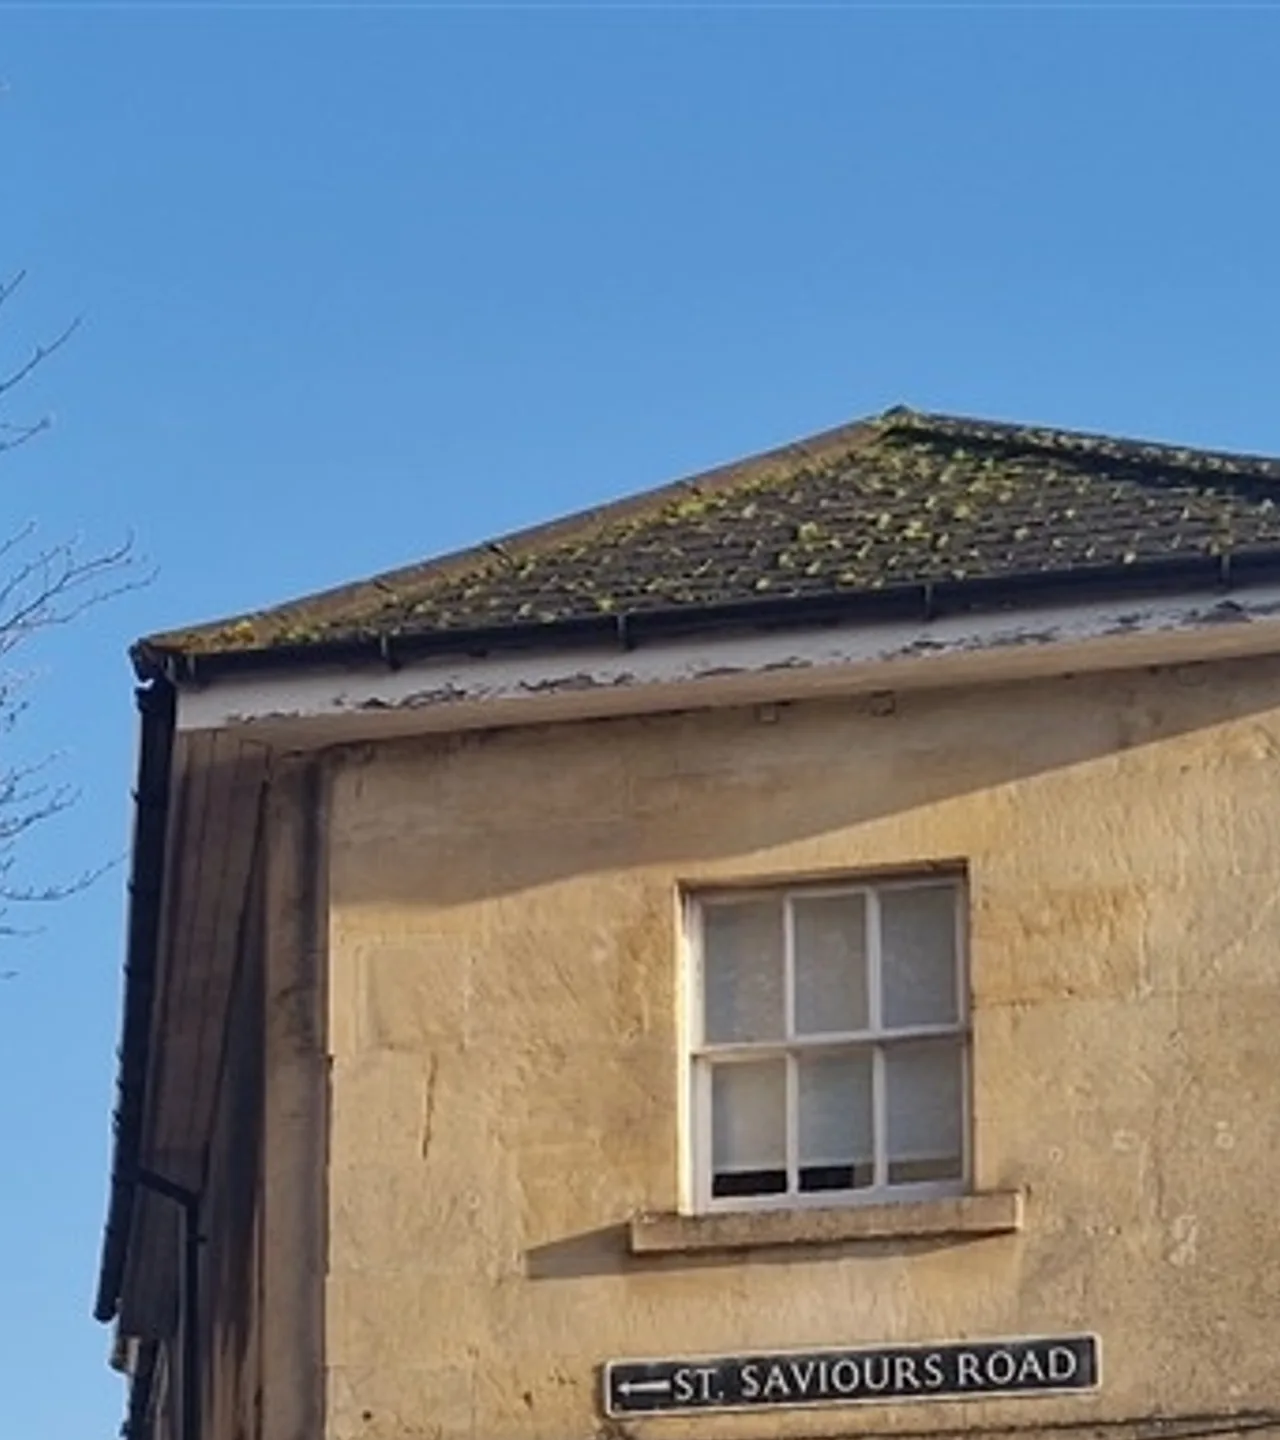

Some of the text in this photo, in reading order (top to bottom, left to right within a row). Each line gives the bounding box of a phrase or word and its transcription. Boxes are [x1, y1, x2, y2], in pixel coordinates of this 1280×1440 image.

[673, 1346, 1077, 1400] ST. SAVIOURS ROAD
